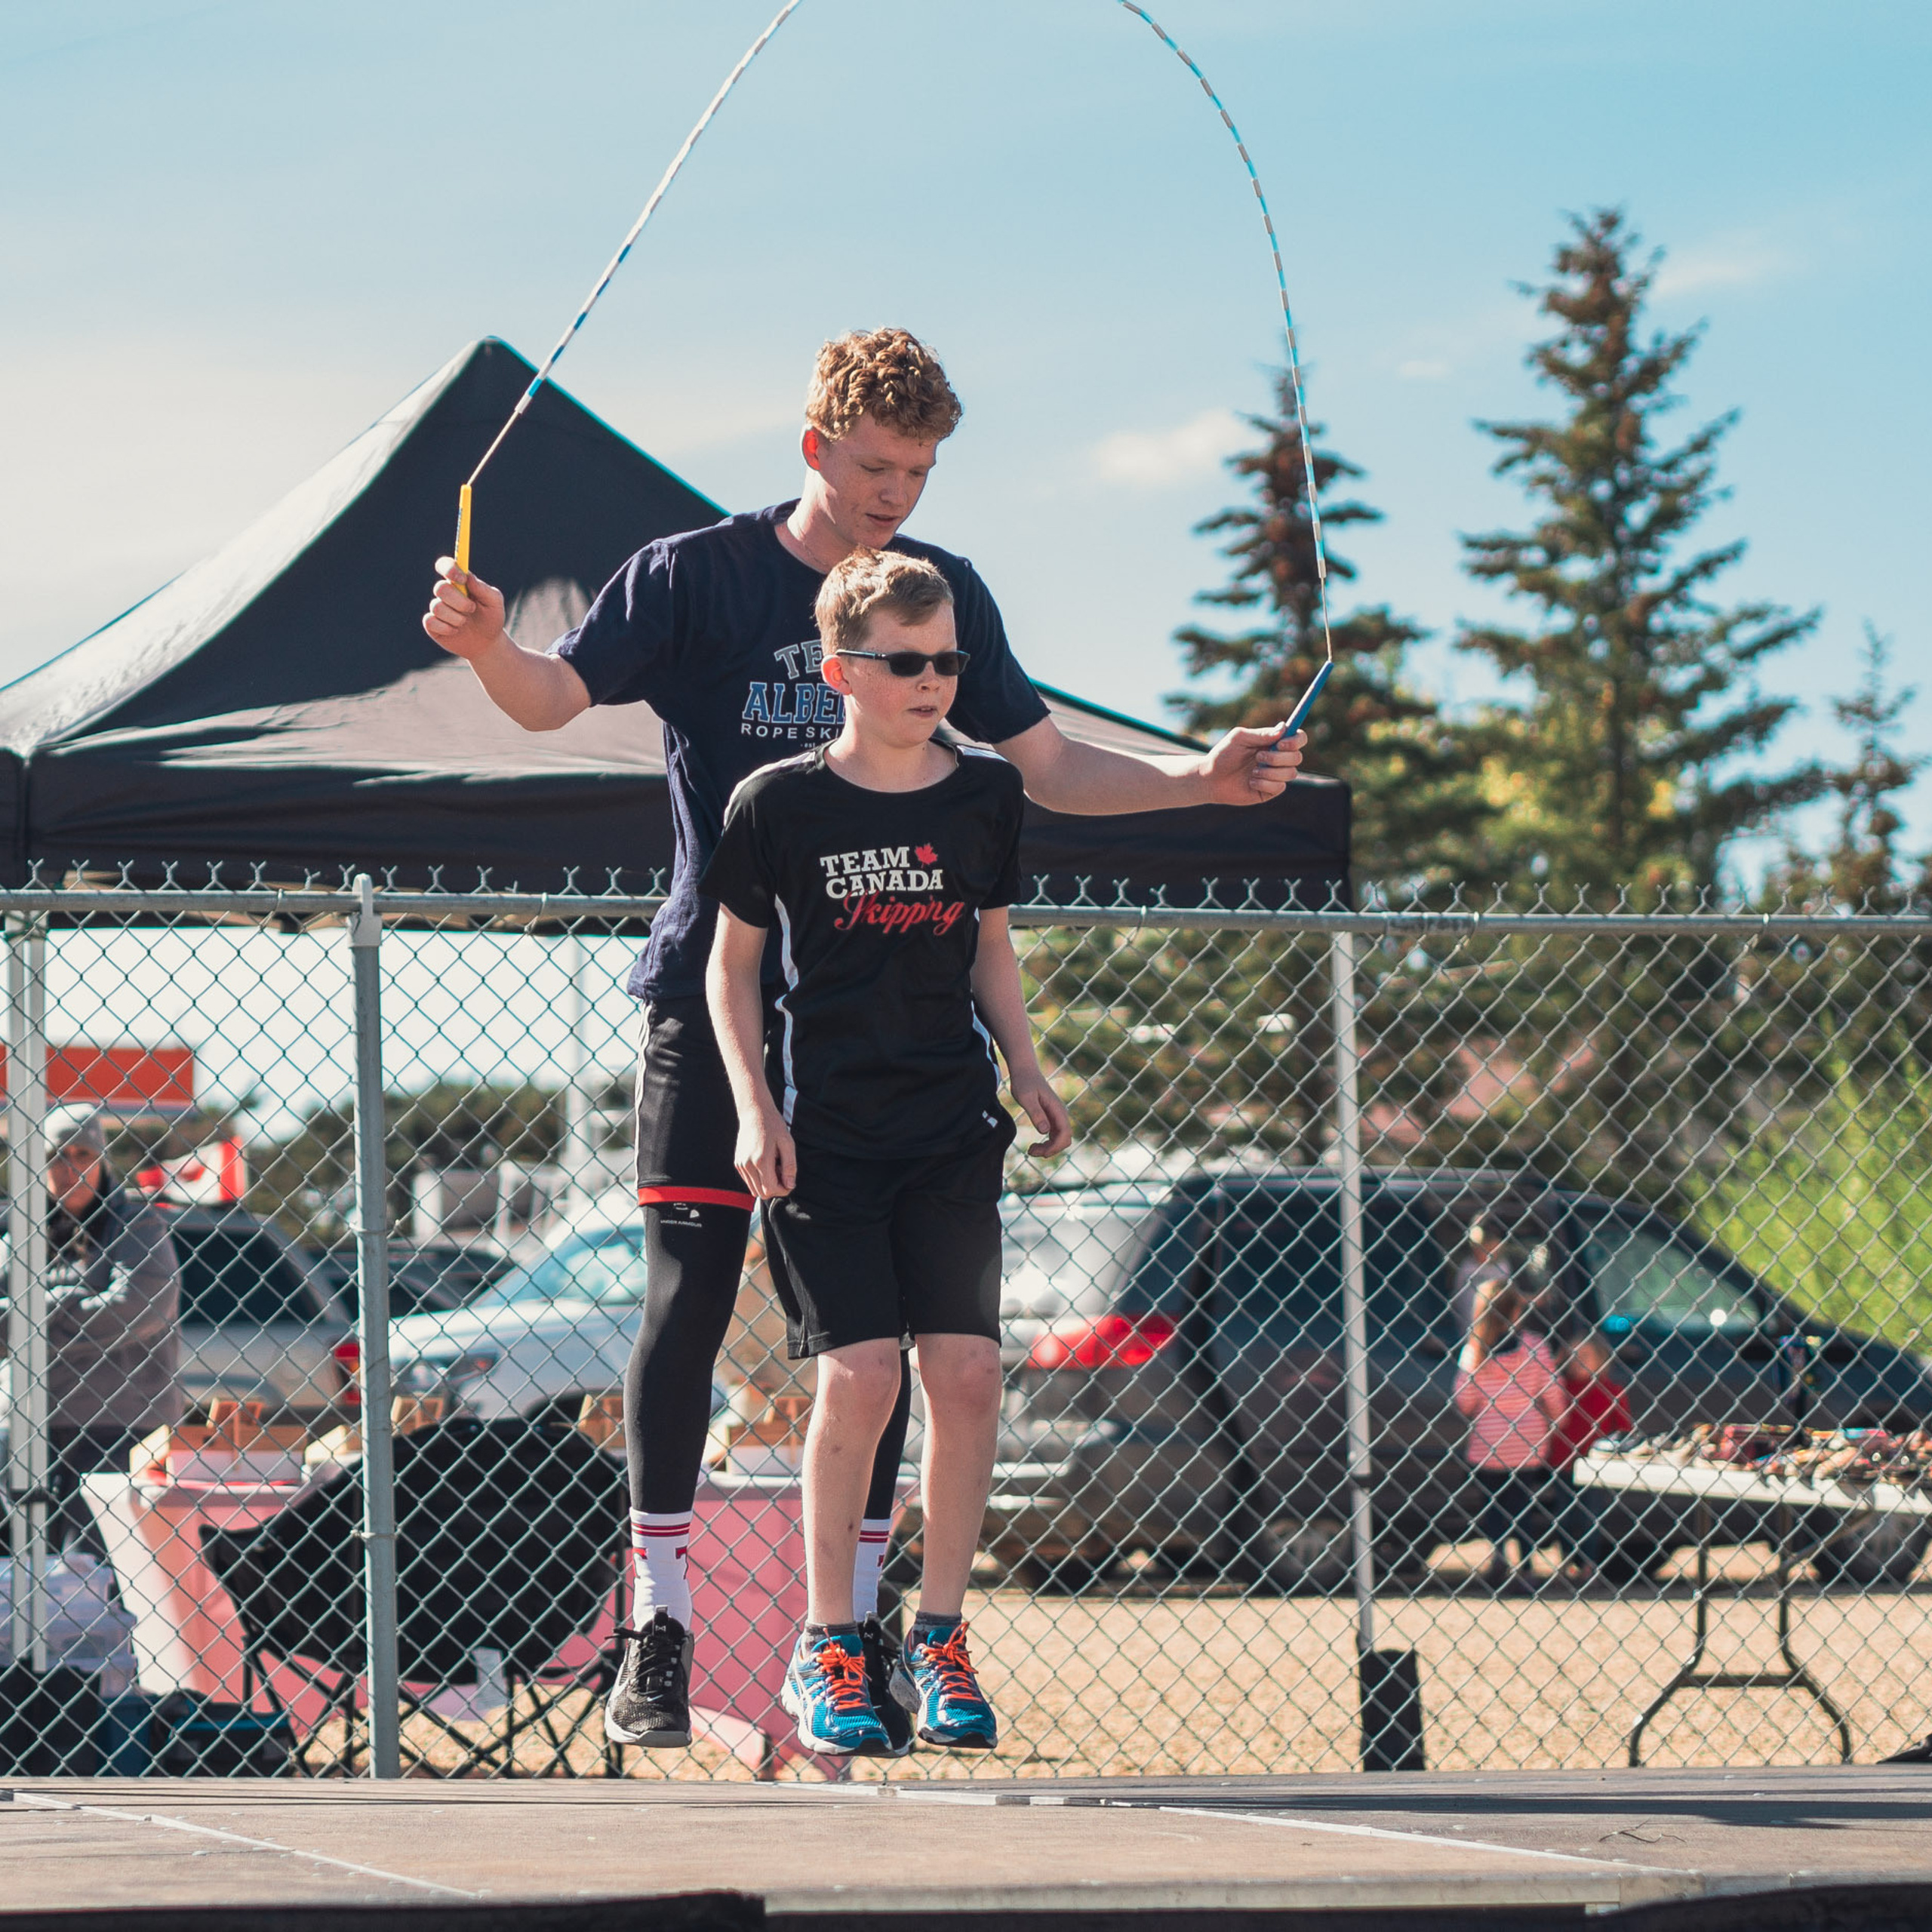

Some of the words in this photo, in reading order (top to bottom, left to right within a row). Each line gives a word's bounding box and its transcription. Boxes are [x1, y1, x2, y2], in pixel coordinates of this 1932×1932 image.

[741, 723, 798, 739] ROPE
[820, 846, 910, 877] TEAM
[826, 869, 943, 899] CANADA
[834, 888, 965, 936] Skipping
